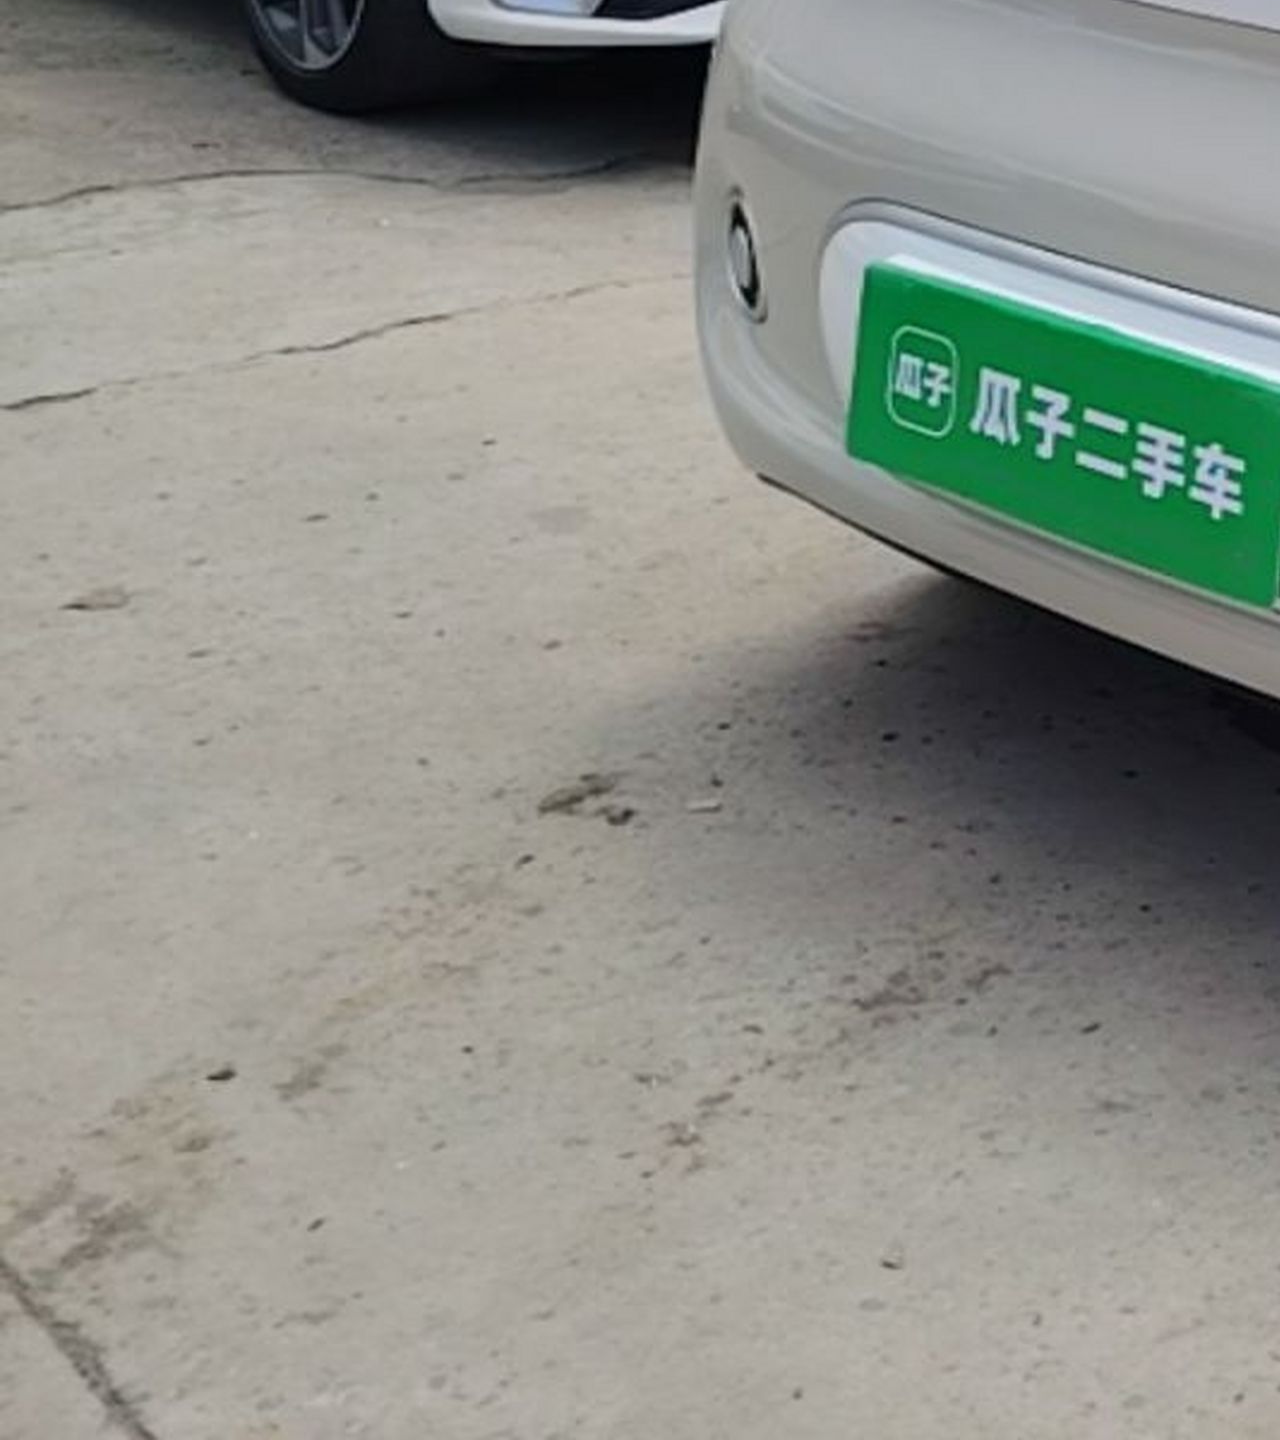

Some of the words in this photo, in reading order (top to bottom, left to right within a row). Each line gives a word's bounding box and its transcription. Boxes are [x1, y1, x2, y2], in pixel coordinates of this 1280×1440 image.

[895, 352, 951, 407] 瓜子
[969, 366, 1245, 520] 瓜子二手车
